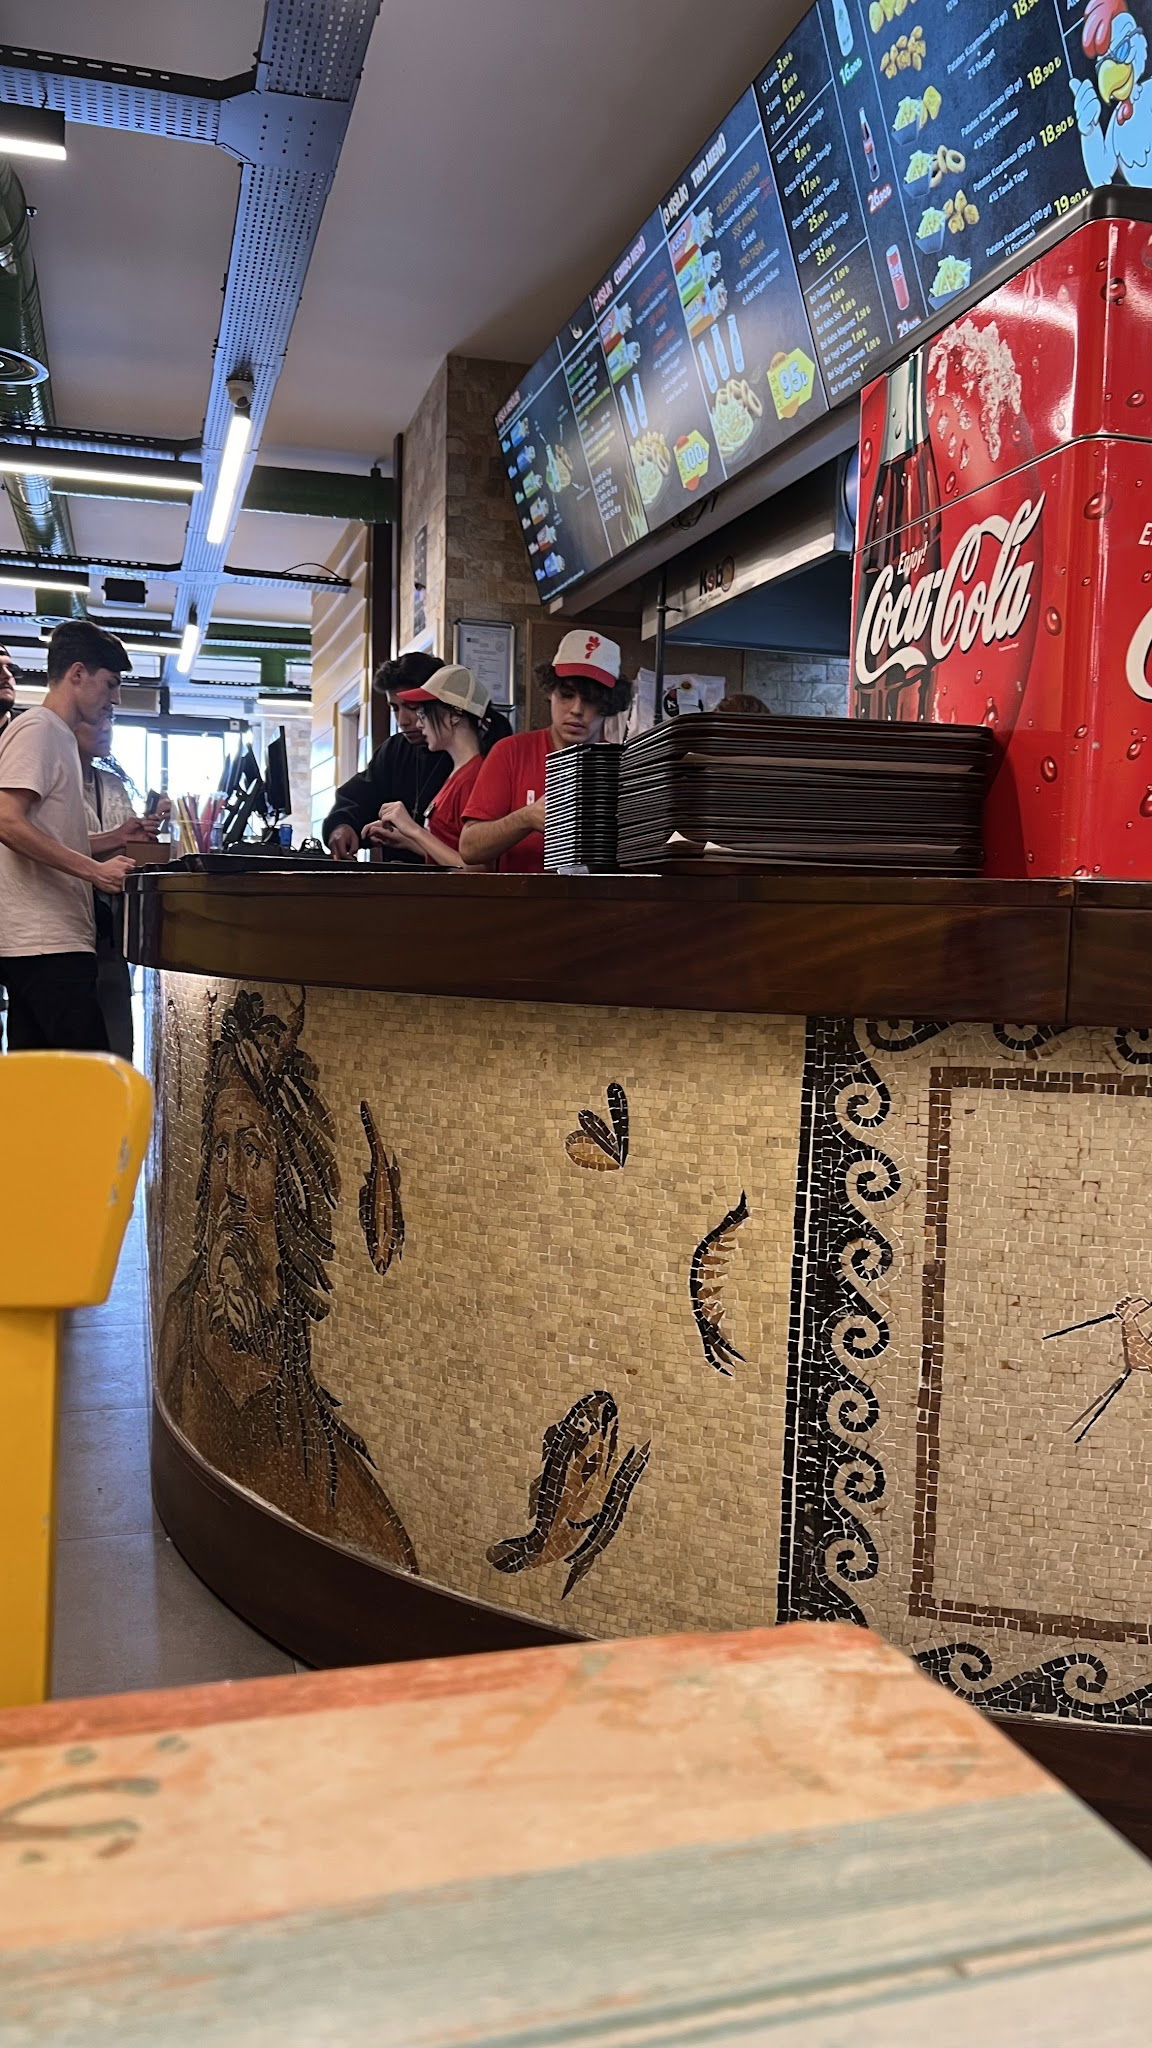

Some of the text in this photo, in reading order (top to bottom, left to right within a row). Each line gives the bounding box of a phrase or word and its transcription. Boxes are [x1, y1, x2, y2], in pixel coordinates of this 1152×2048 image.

[1028, 62, 1054, 89] 18,90
[1040, 121, 1067, 146] 18,90
[896, 542, 928, 576] Enjoy!
[855, 490, 1046, 685] Coca-Cola
